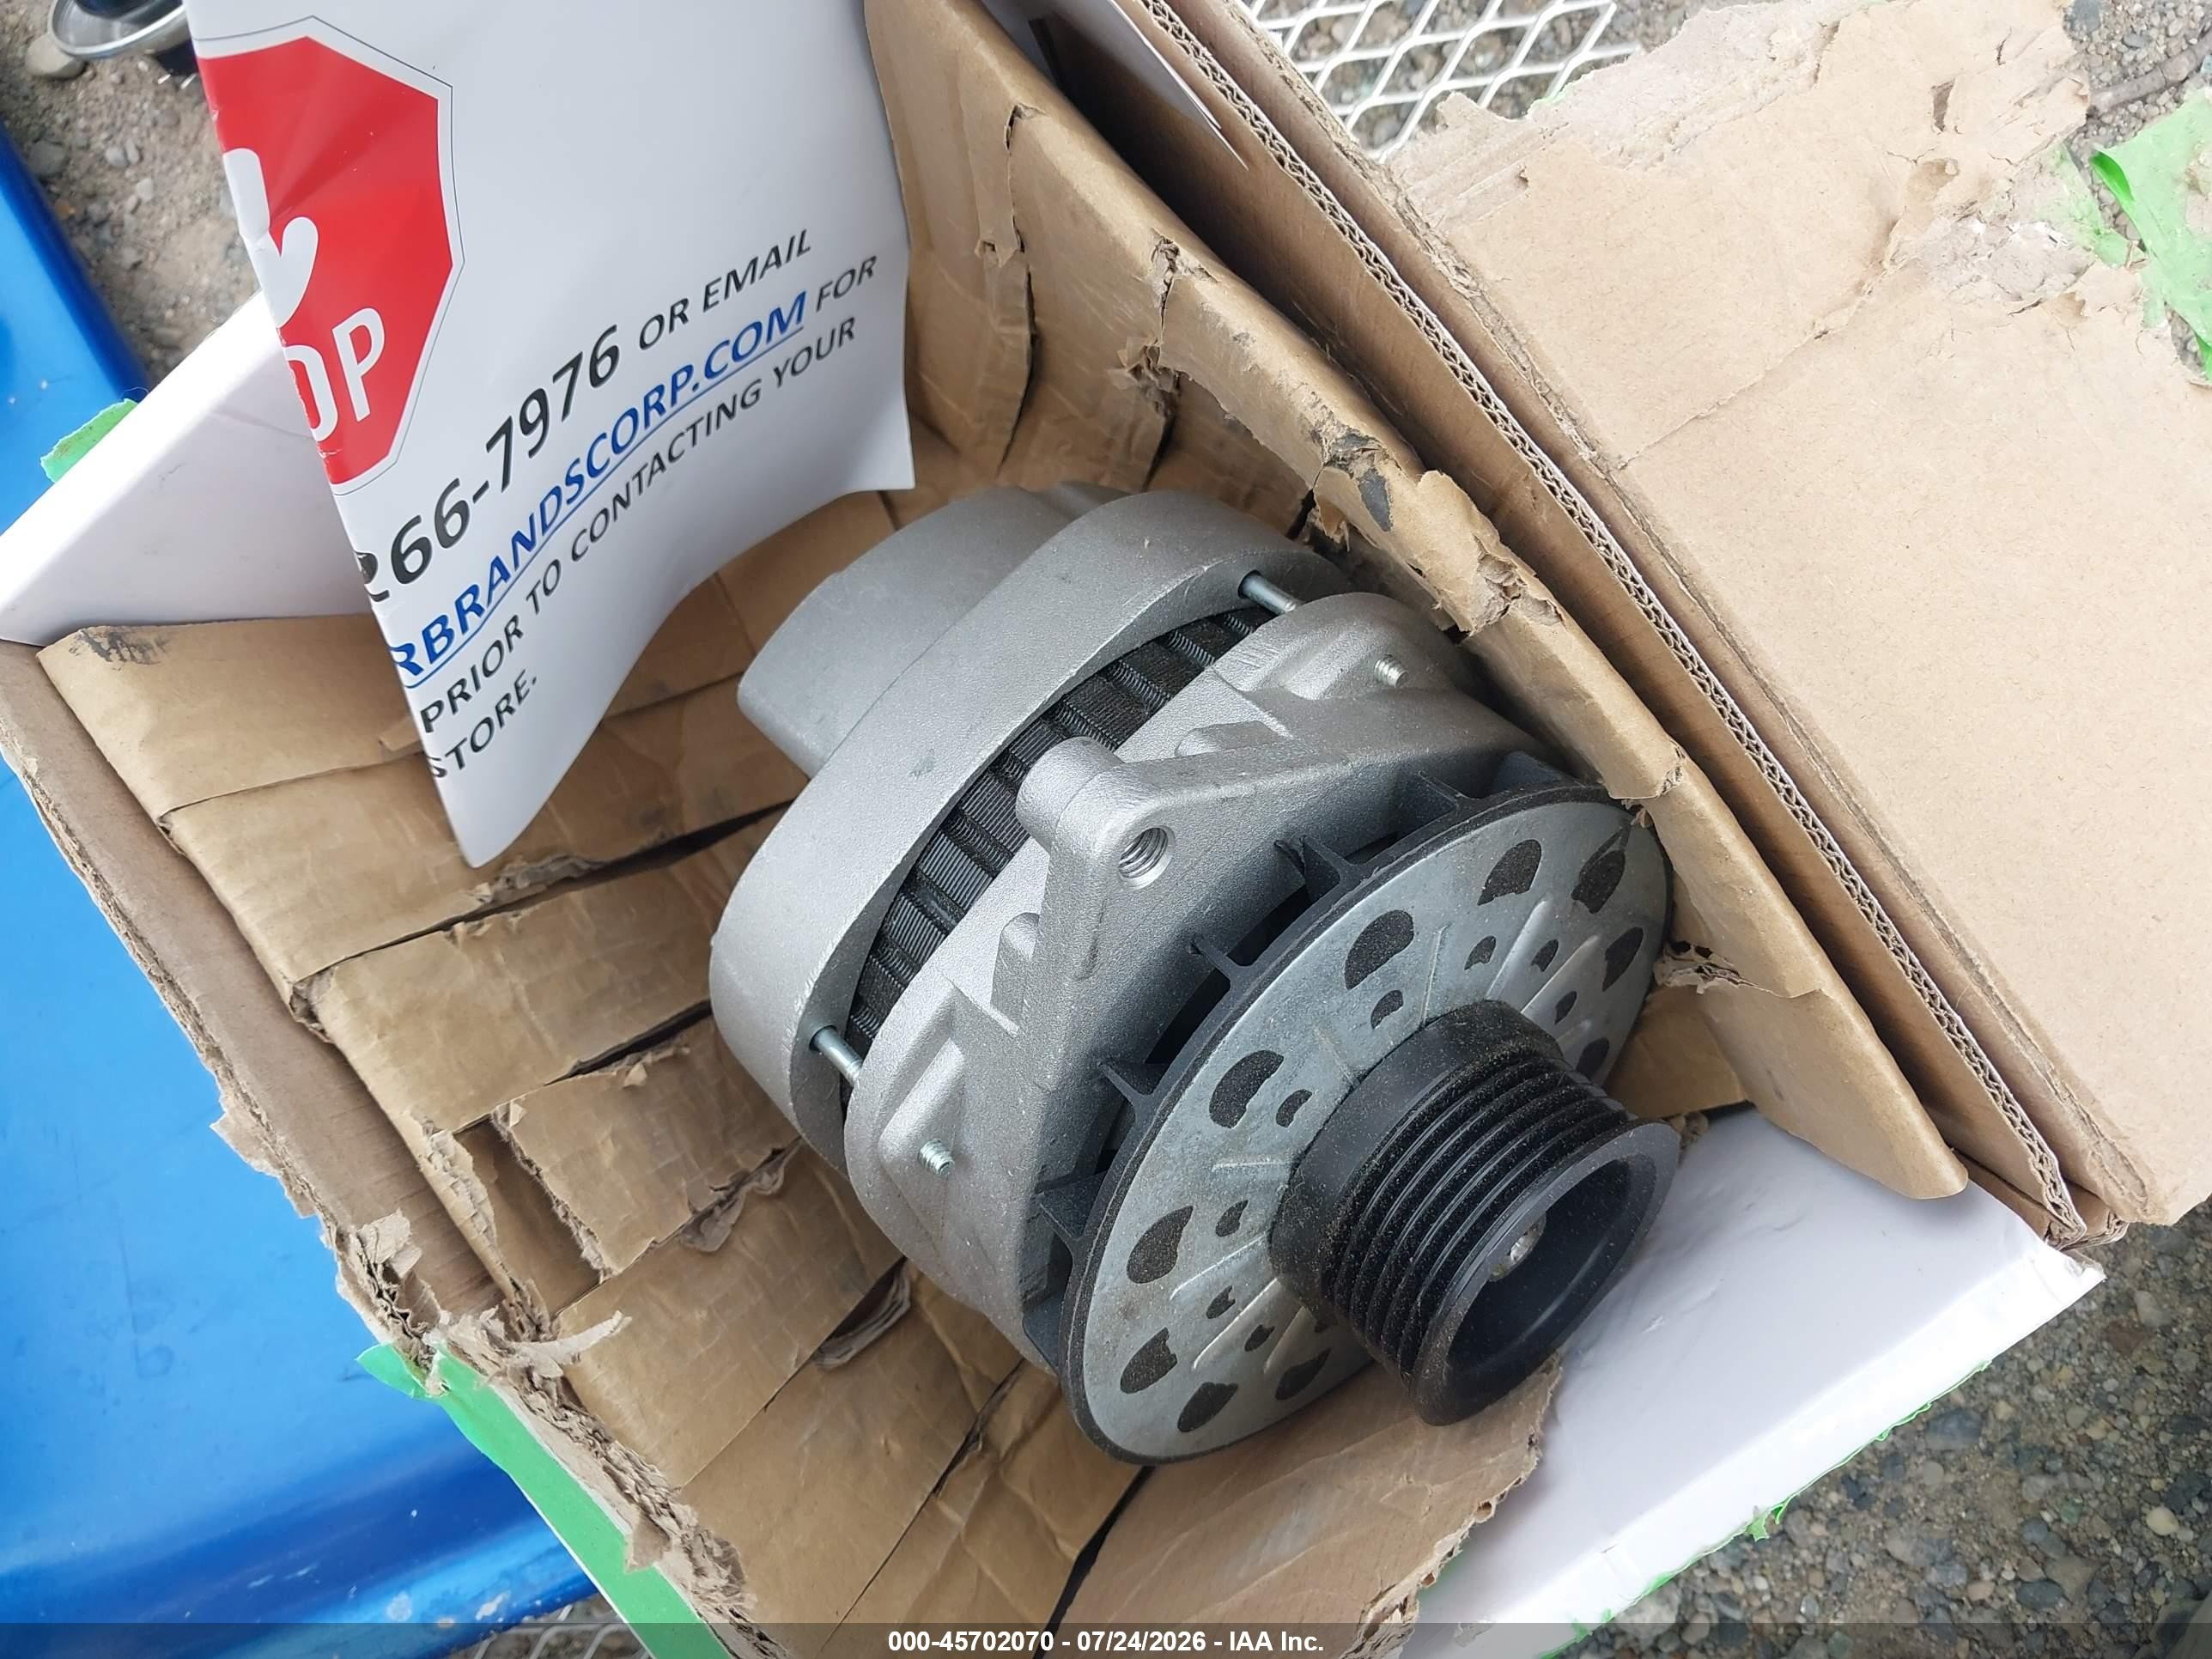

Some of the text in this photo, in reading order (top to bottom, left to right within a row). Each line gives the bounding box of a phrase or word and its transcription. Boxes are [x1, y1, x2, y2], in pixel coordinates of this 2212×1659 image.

[639, 298, 690, 350] OR
[702, 228, 811, 313] EMAIL
[816, 255, 877, 313] FOR
[420, 317, 855, 733] PRIOR TO CONTACTING YOUR
